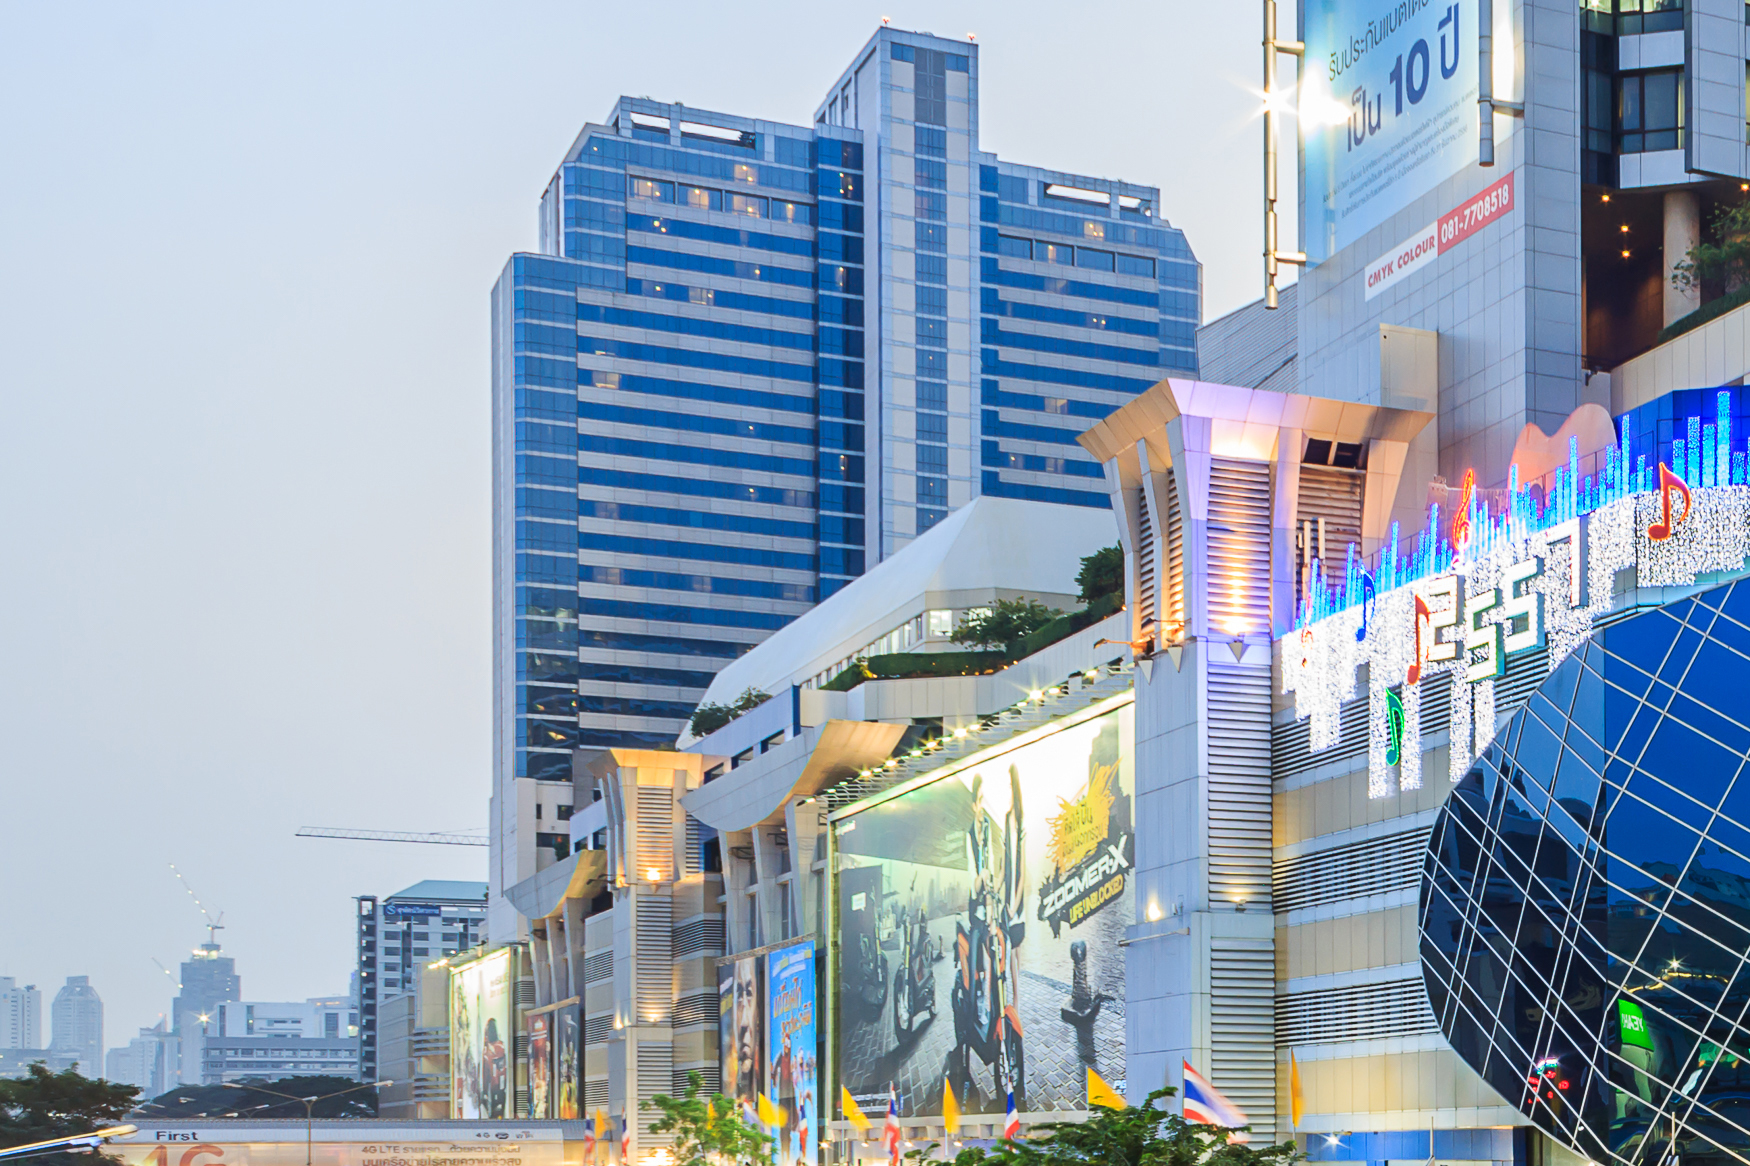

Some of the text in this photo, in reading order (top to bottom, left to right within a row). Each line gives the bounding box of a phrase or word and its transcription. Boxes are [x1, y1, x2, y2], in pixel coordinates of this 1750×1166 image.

[1347, 85, 1381, 152] เป็น
[1390, 38, 1430, 117] 10
[1437, 2, 1460, 80] ปี
[1368, 183, 1510, 289] CMYK COLOUR 081-7708518
[156, 1131, 199, 1141] First
[362, 1146, 377, 1154] 4G
[379, 1146, 400, 1154] LTE
